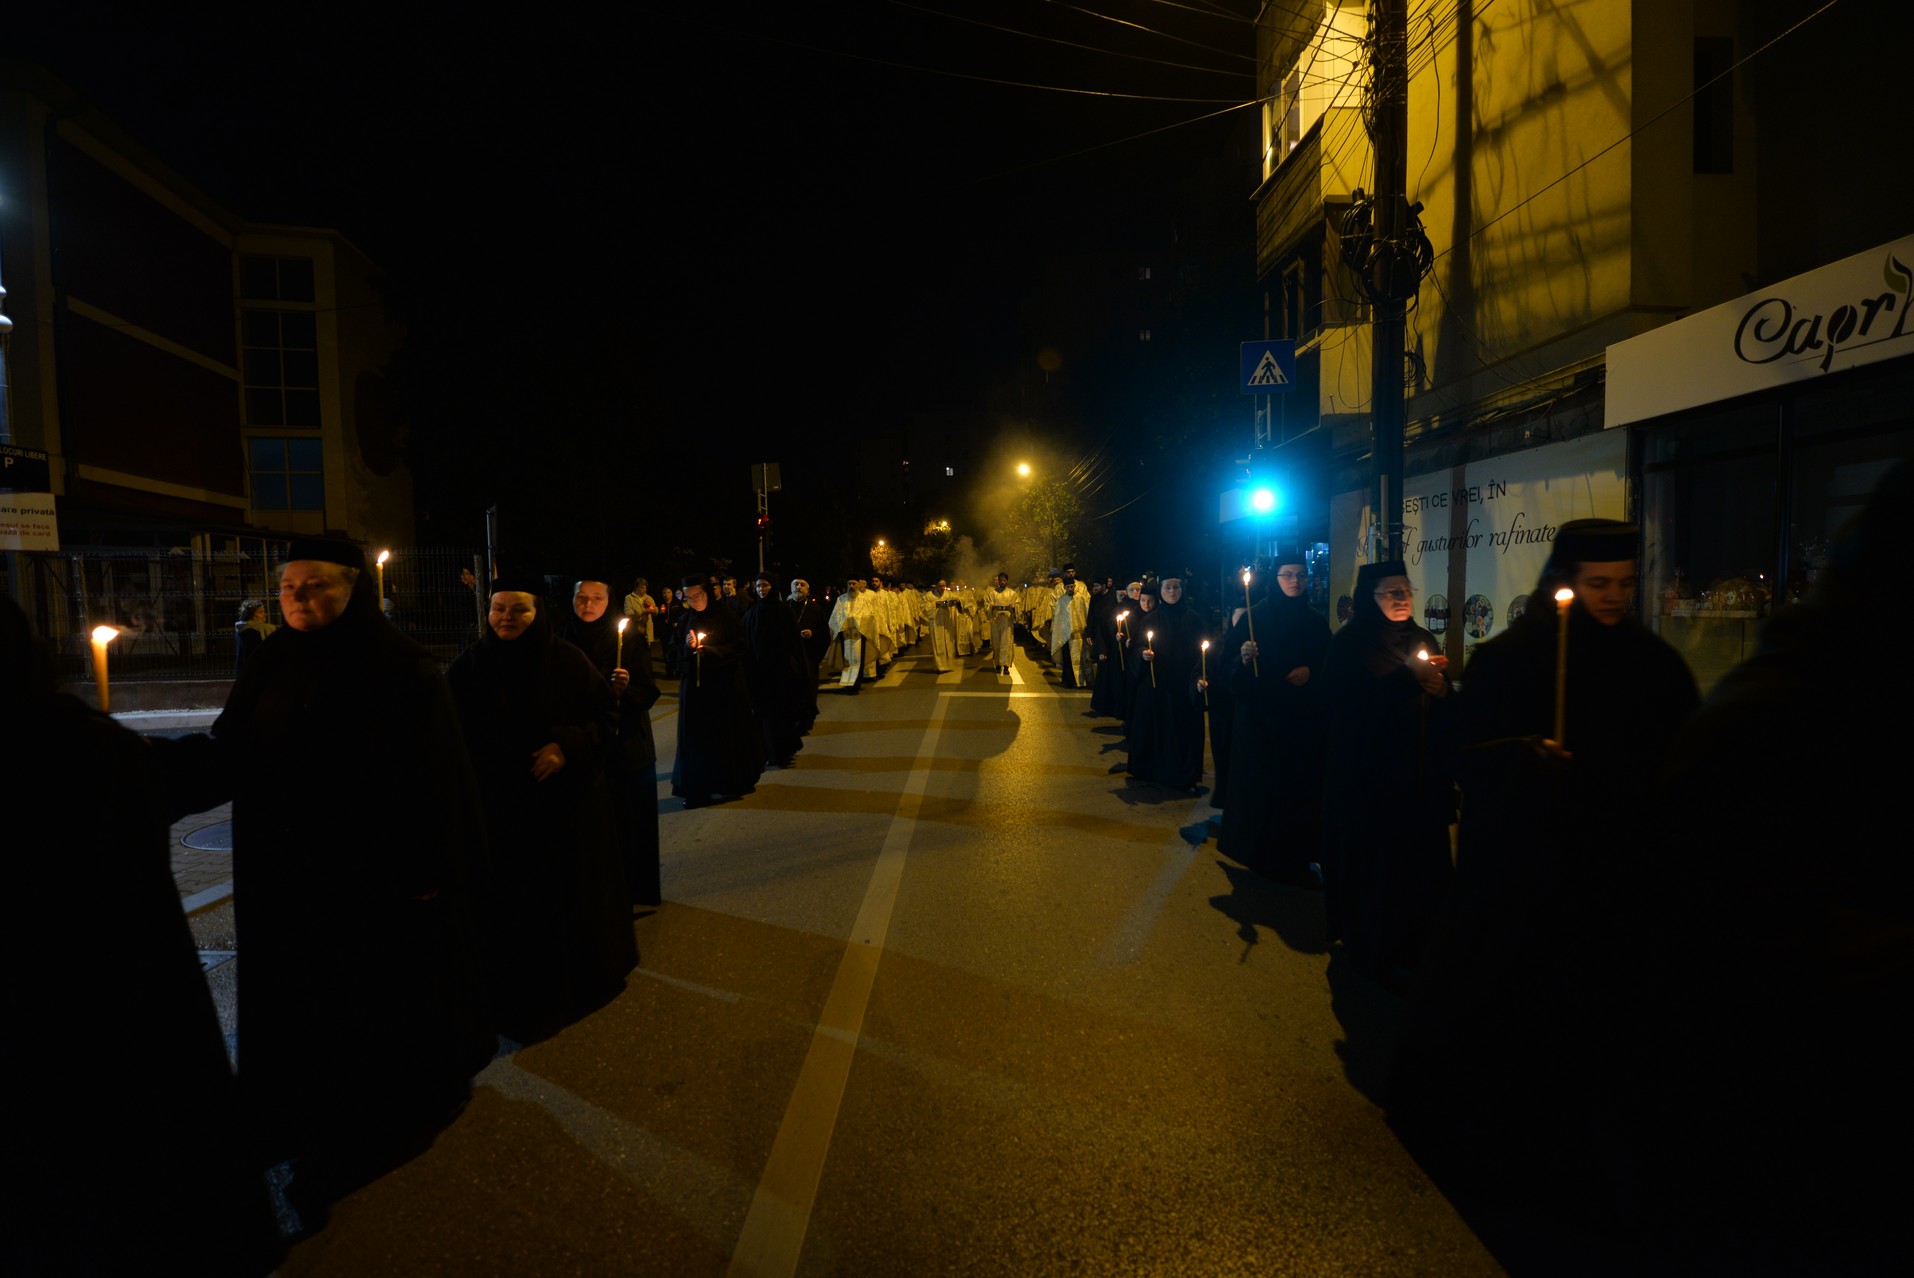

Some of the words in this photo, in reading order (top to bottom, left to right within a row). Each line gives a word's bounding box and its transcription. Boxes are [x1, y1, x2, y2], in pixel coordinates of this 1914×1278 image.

[25, 450, 47, 461] LIBERE
[5, 457, 14, 468] P
[1431, 493, 1448, 508] CE
[1452, 486, 1484, 505] VREI,
[1487, 479, 1507, 500] ÎN
[20, 507, 55, 516] privată
[1411, 518, 1483, 566] gusturilor
[1489, 512, 1557, 555] rafinate
